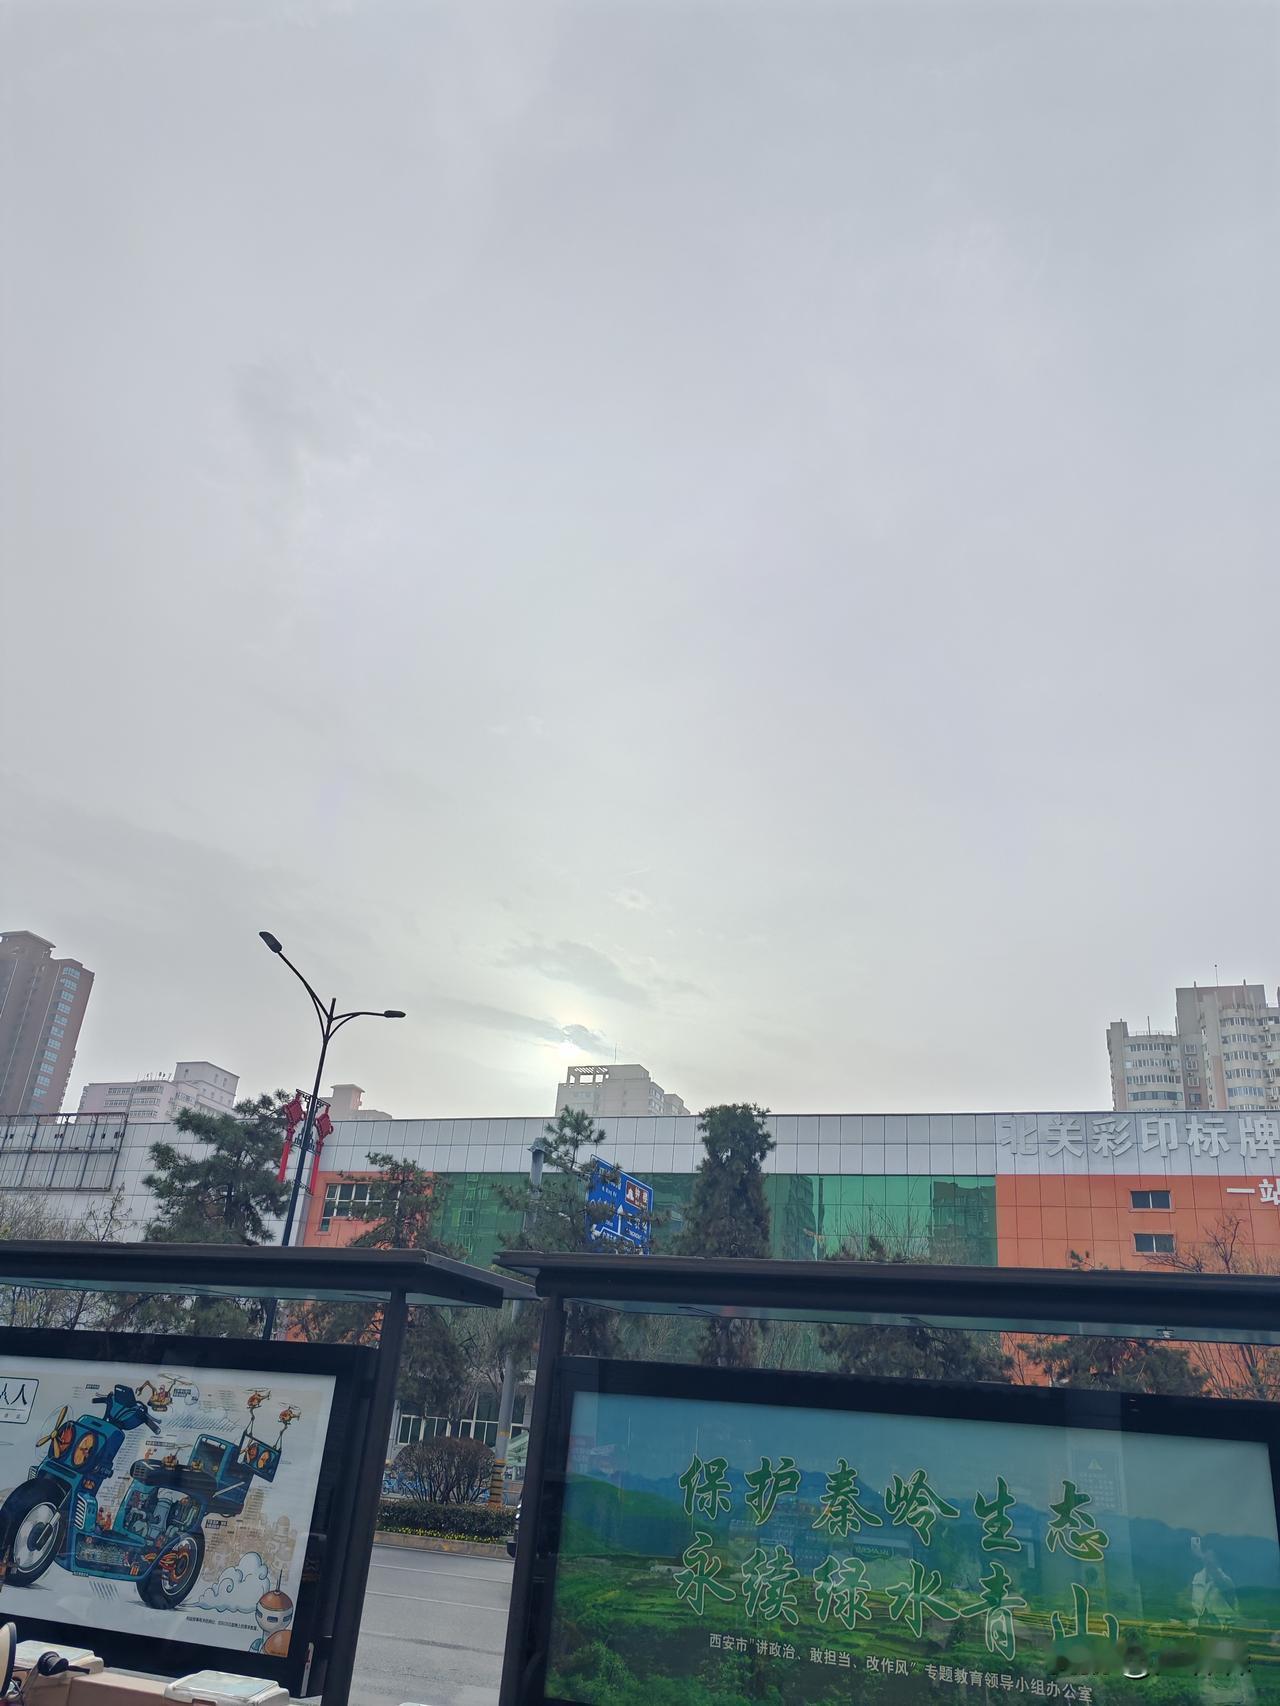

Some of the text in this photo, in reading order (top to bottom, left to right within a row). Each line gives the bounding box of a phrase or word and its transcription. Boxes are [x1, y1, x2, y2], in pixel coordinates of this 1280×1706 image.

[679, 1453, 1109, 1562] 保护秦岭生态
[673, 1531, 1120, 1661] 永续绿水青山
